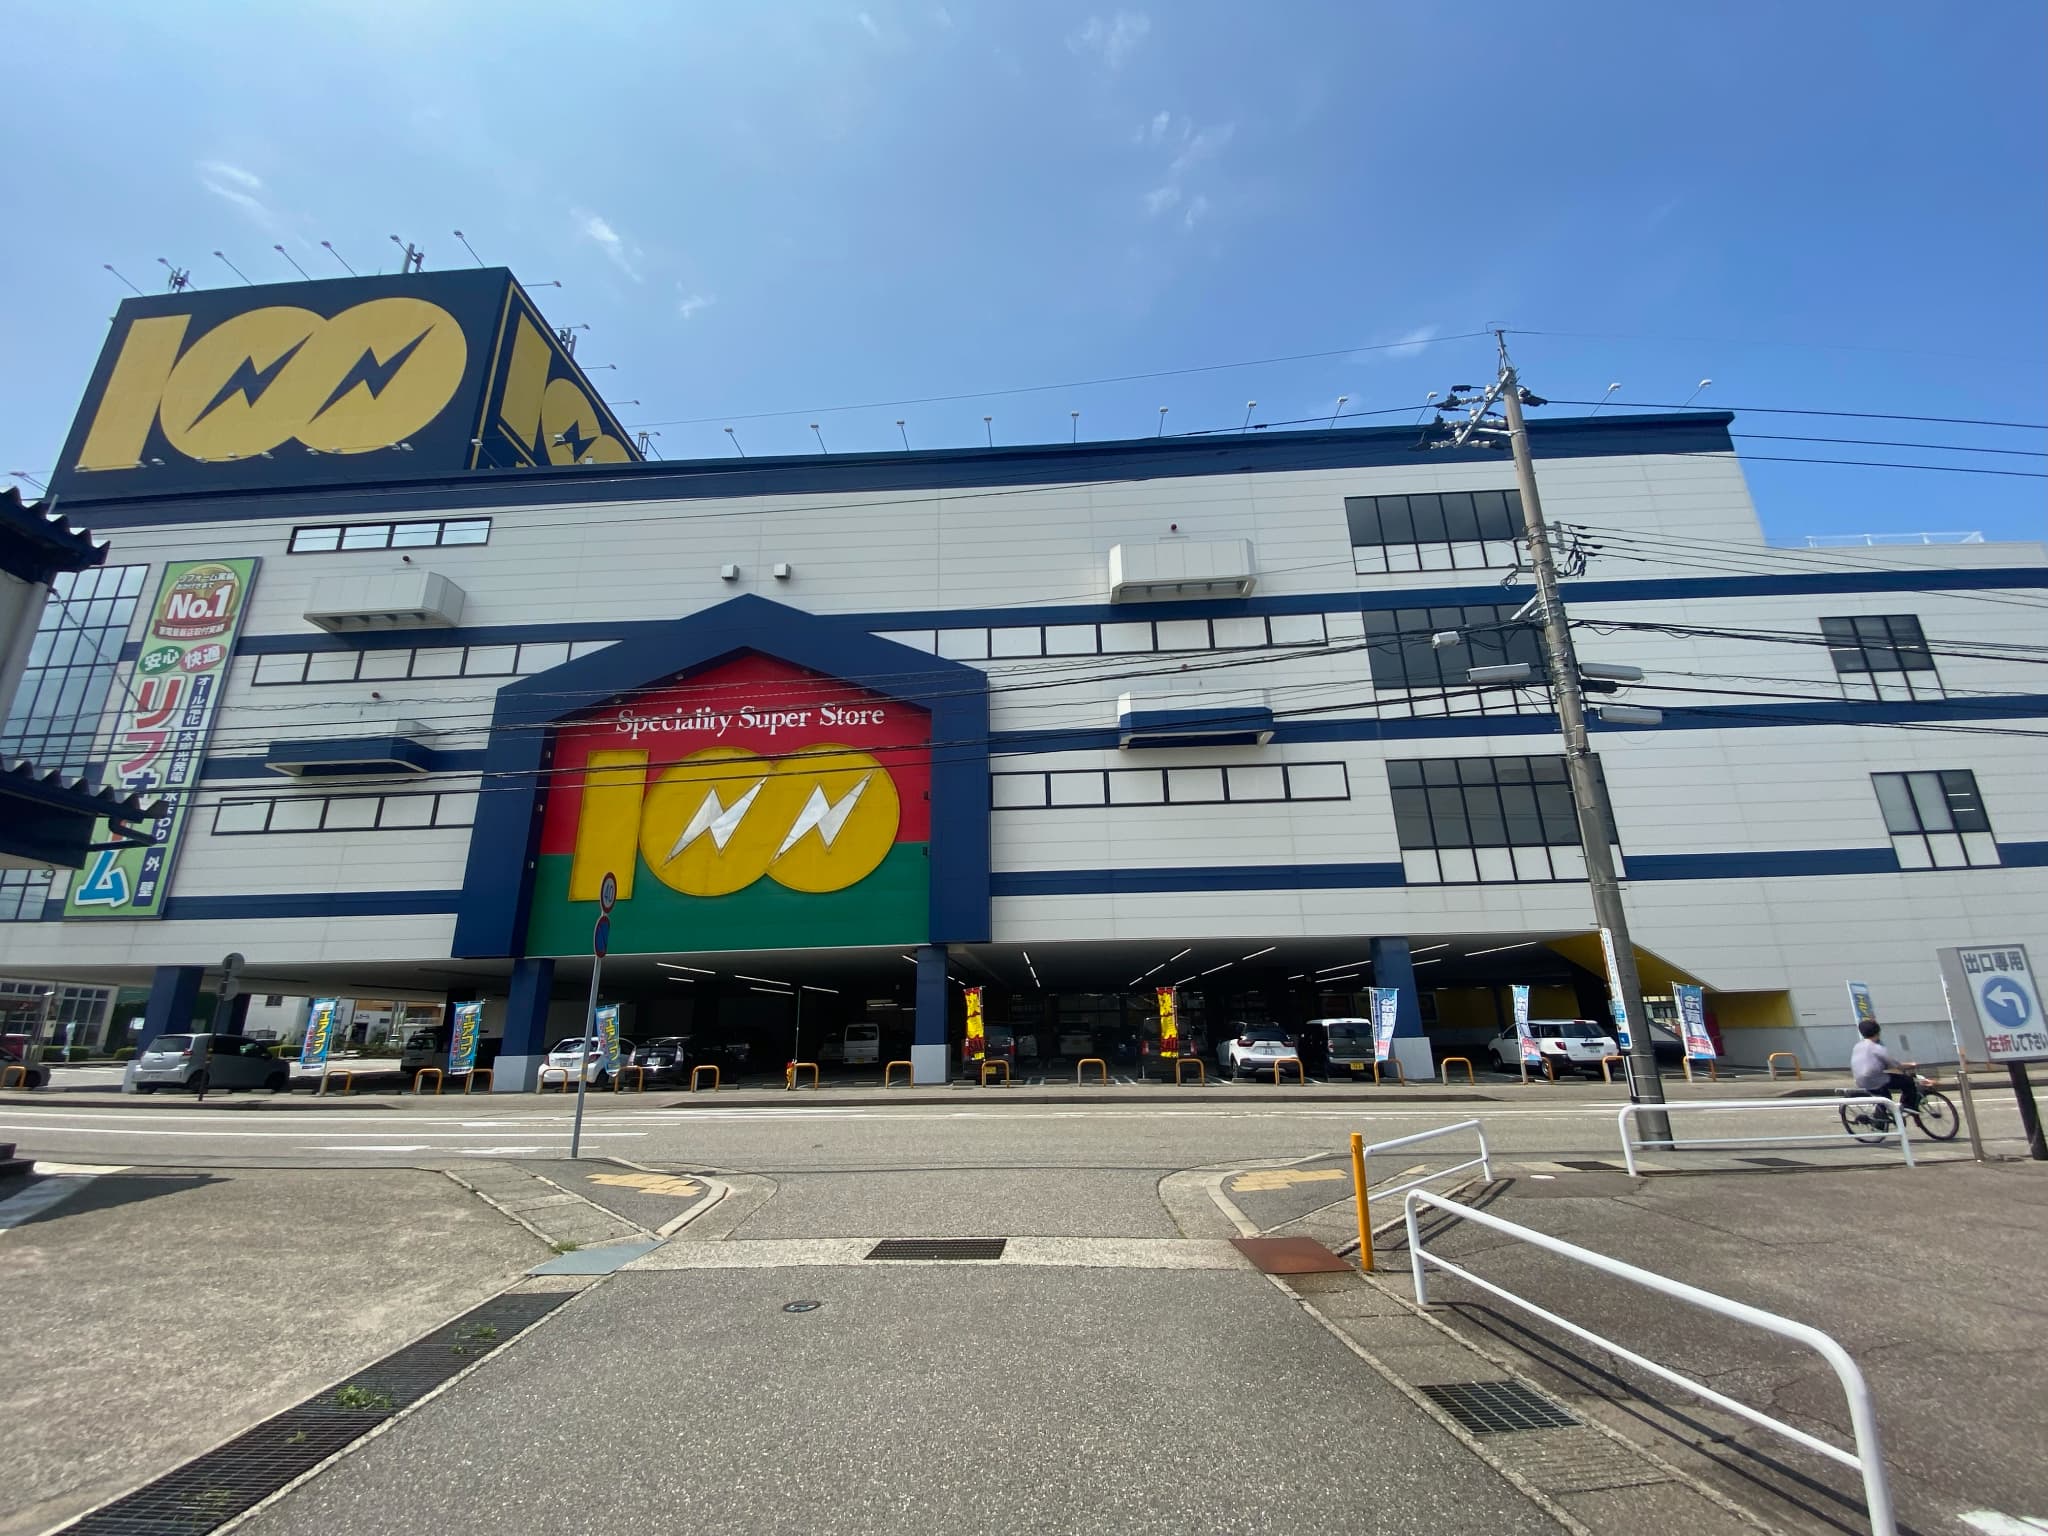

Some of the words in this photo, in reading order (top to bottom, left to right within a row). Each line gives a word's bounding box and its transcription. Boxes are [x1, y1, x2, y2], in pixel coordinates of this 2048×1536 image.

[75, 298, 468, 472] 100
[167, 585, 232, 619] No.1
[144, 649, 180, 671] 安心
[184, 645, 221, 669] 快適
[186, 677, 211, 726] オール電化
[615, 706, 732, 740] Speciality
[738, 705, 811, 735] Super
[819, 703, 885, 727] Store
[170, 732, 195, 782] 太陽光発電
[568, 742, 901, 902] 100
[138, 856, 160, 897] 外壁
[1963, 951, 2025, 974] 出口専用
[312, 1010, 332, 1055] エアコン
[459, 1015, 476, 1057] エアコン
